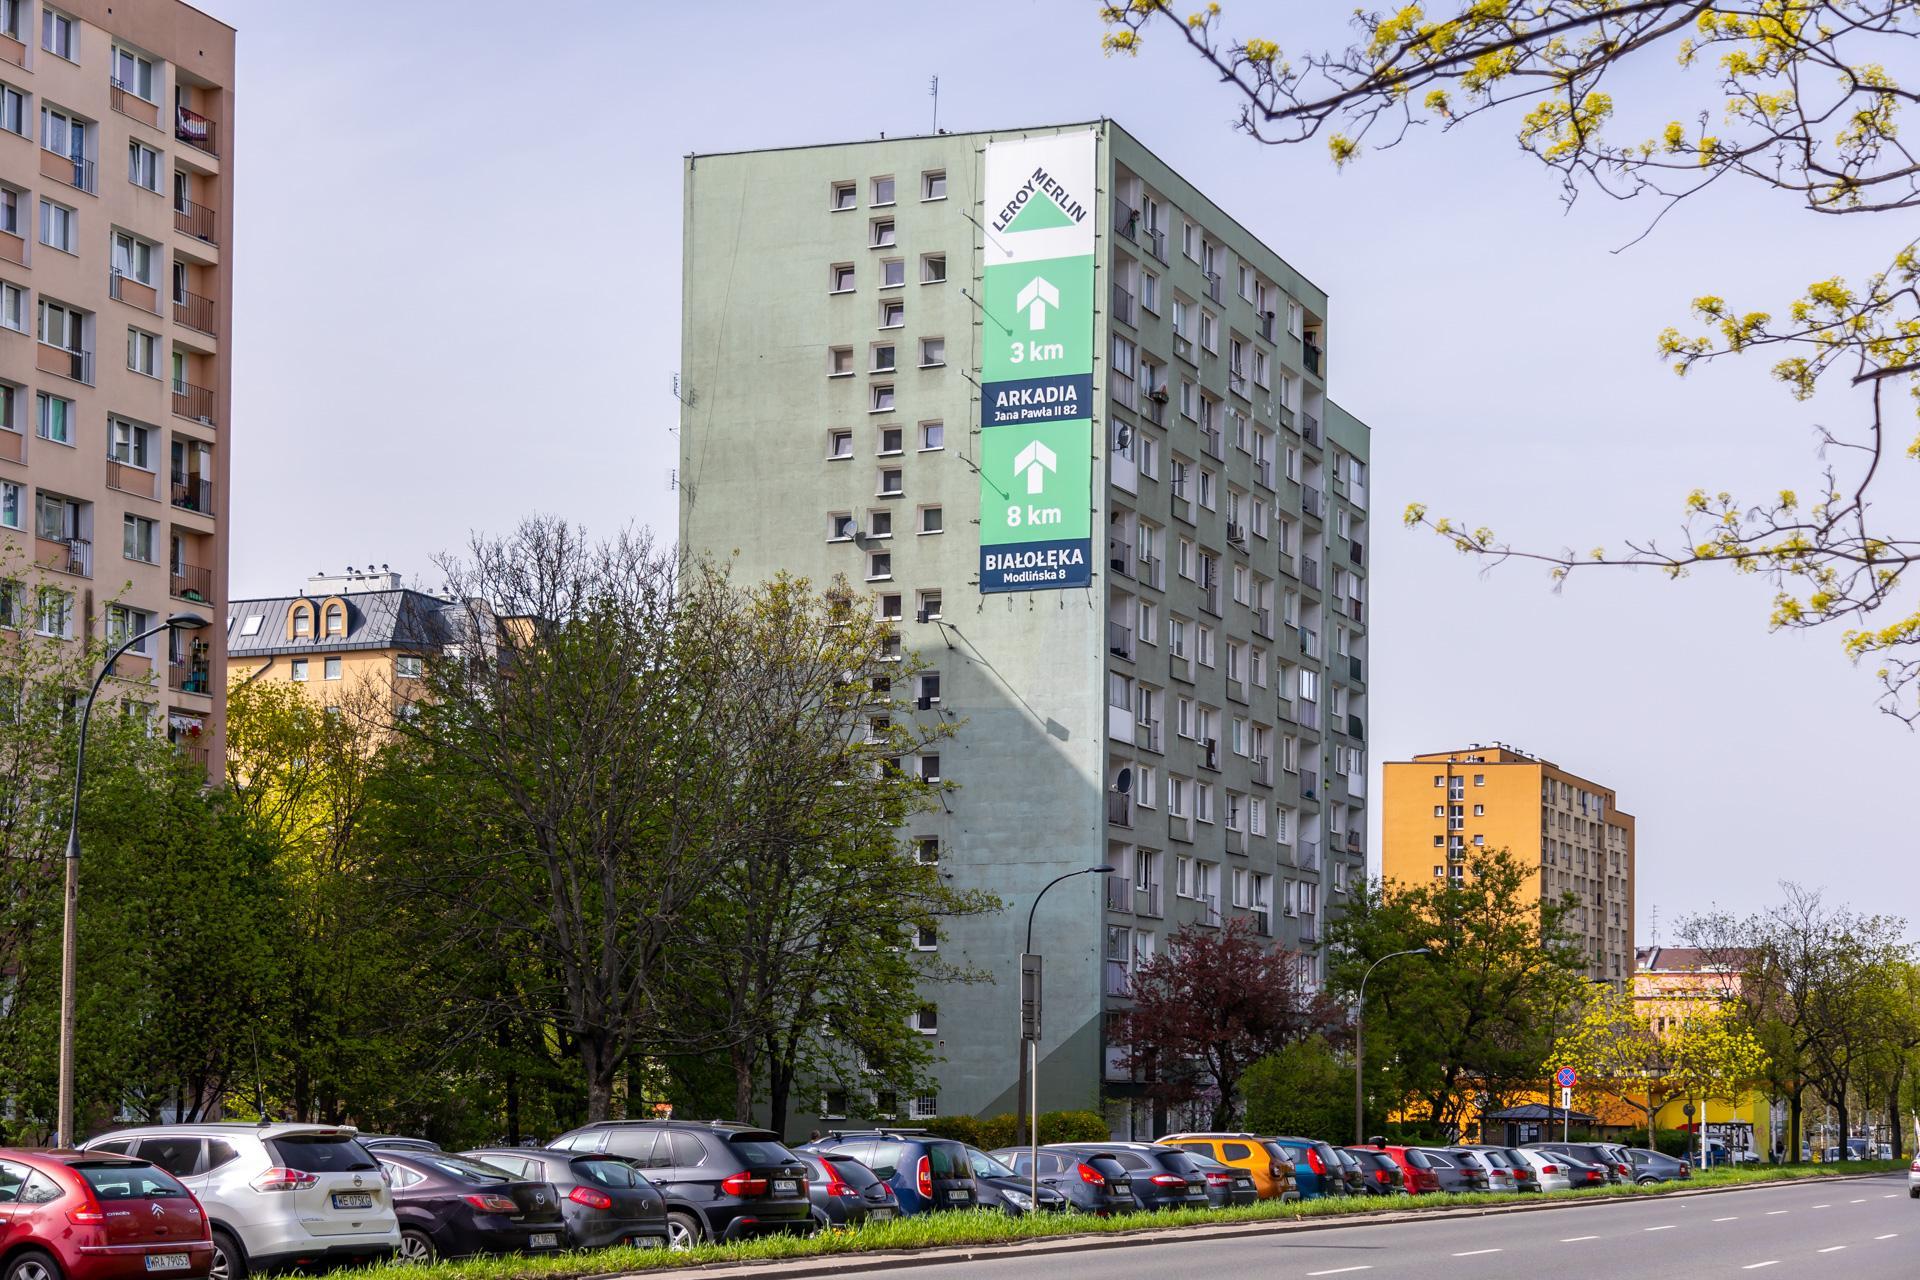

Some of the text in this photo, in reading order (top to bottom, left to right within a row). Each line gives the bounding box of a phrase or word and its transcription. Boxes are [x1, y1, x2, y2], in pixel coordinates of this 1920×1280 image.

[992, 167, 1087, 232] LEROY MERLIN
[1010, 341, 1064, 363] 3 km
[996, 385, 1077, 407] ARKADIA
[994, 404, 1077, 421] Jana Pawła II 82
[1007, 505, 1061, 527] 8 km
[985, 549, 1084, 570] BIAŁOŁĘKA
[1003, 569, 1066, 583] Modlińska 8
